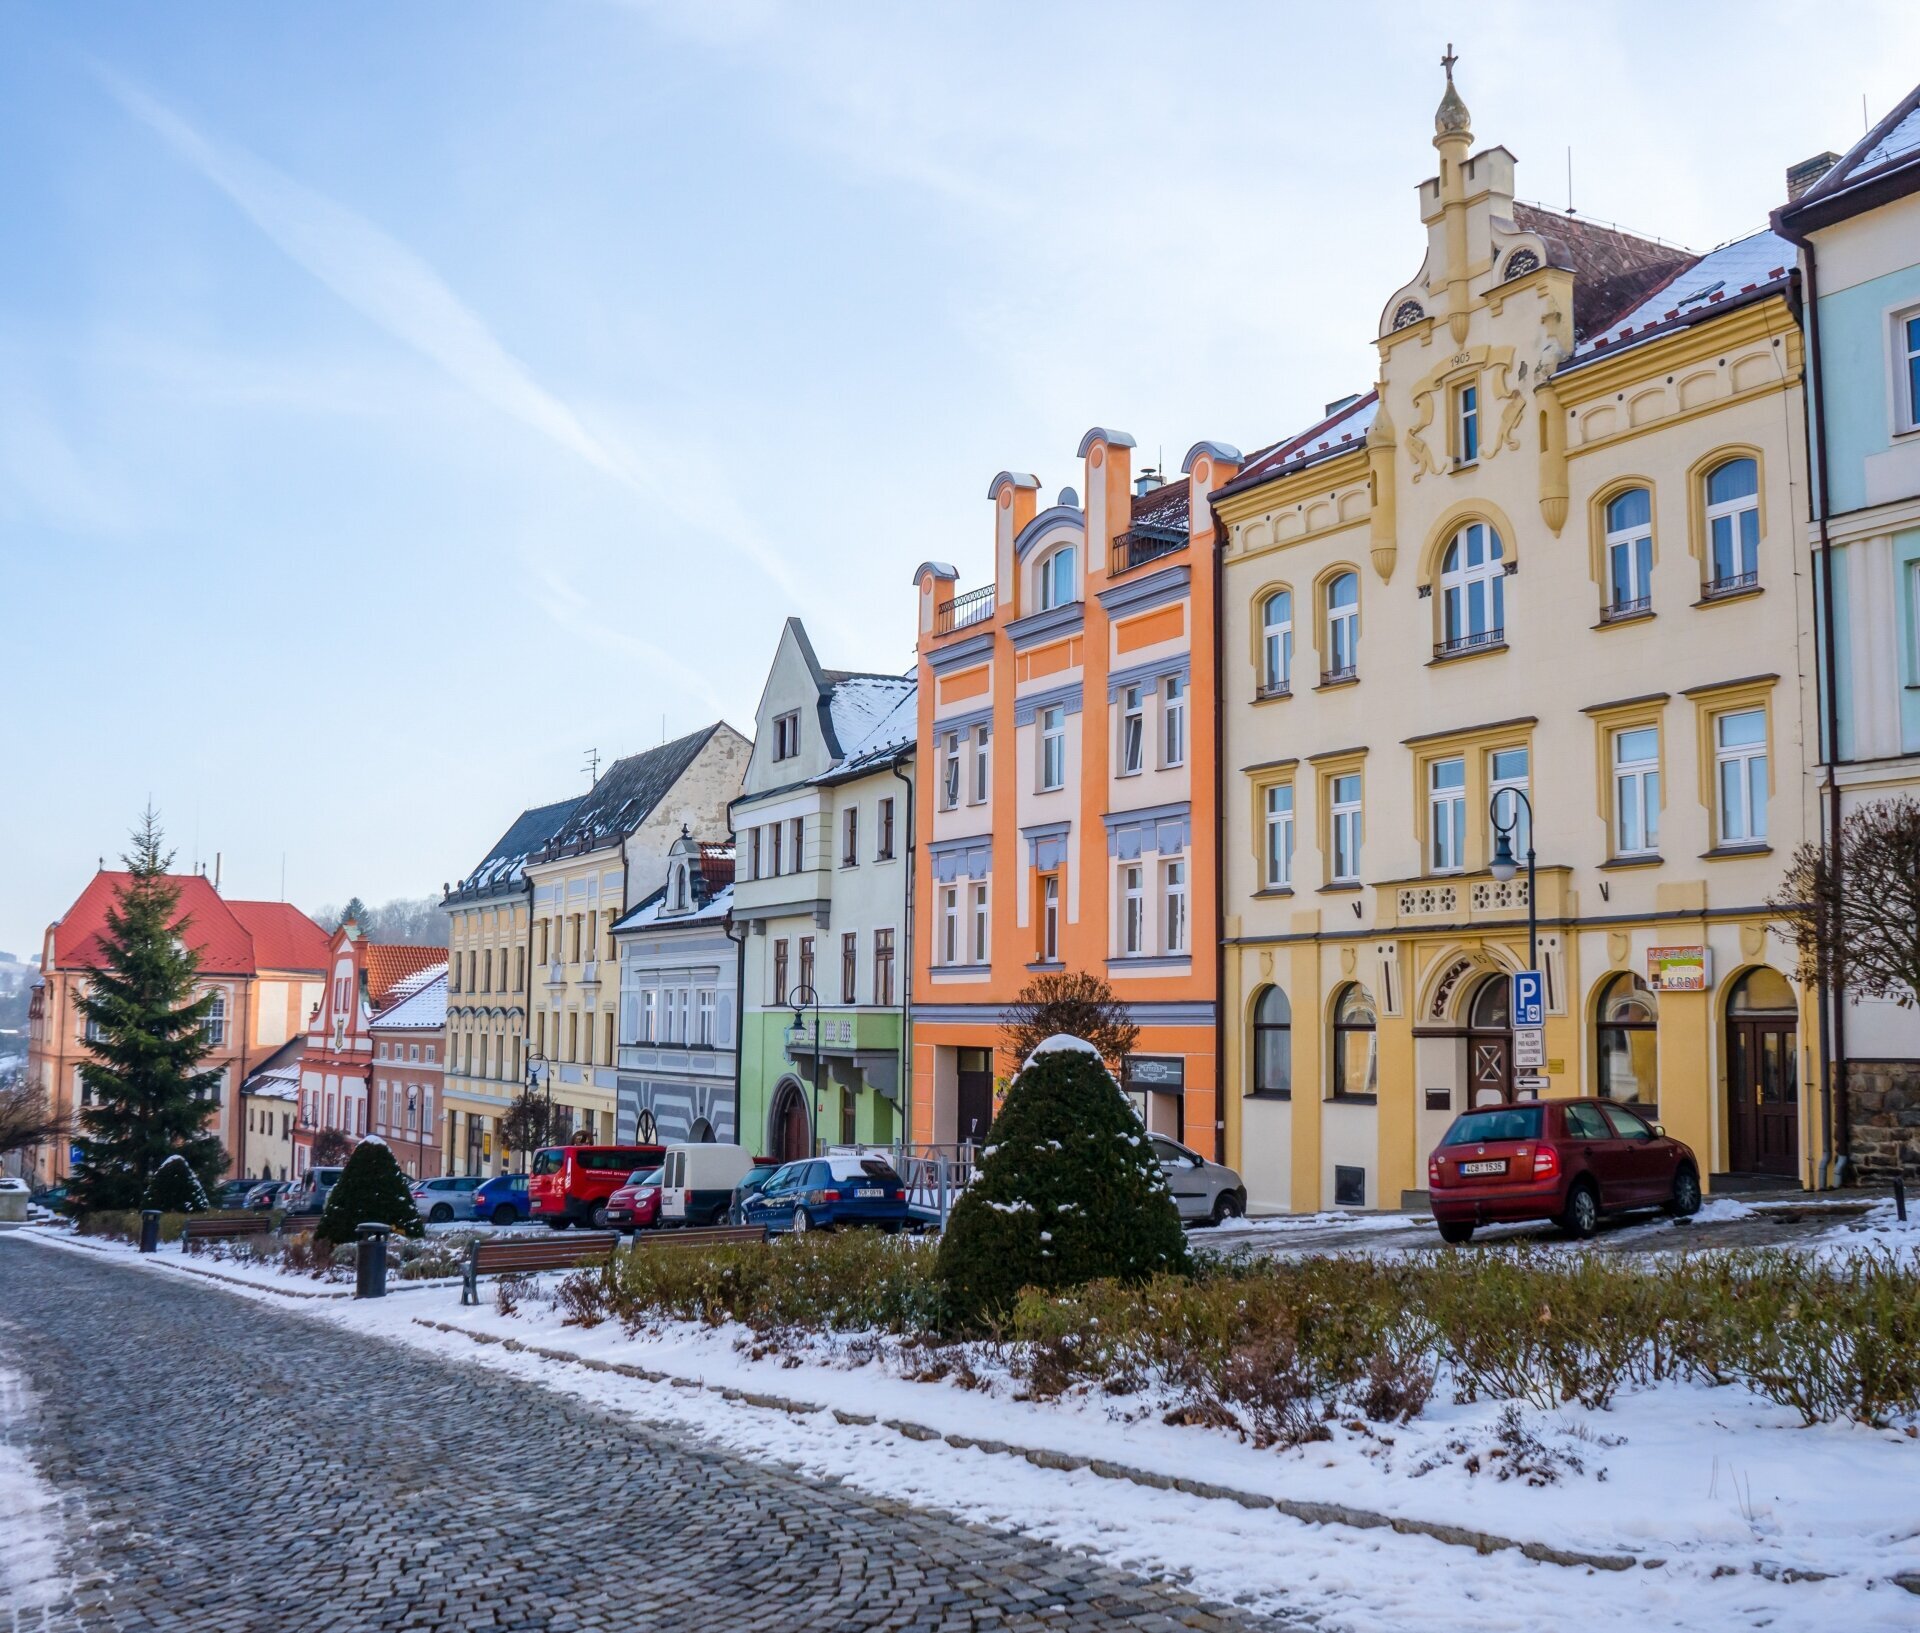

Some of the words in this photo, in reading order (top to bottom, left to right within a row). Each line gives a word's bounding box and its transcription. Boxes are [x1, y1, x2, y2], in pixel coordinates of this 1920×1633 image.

[1450, 352, 1471, 367] 1905
[1473, 954, 1487, 964] 15
[1668, 976, 1699, 988] KRBY
[1519, 978, 1536, 1009] P
